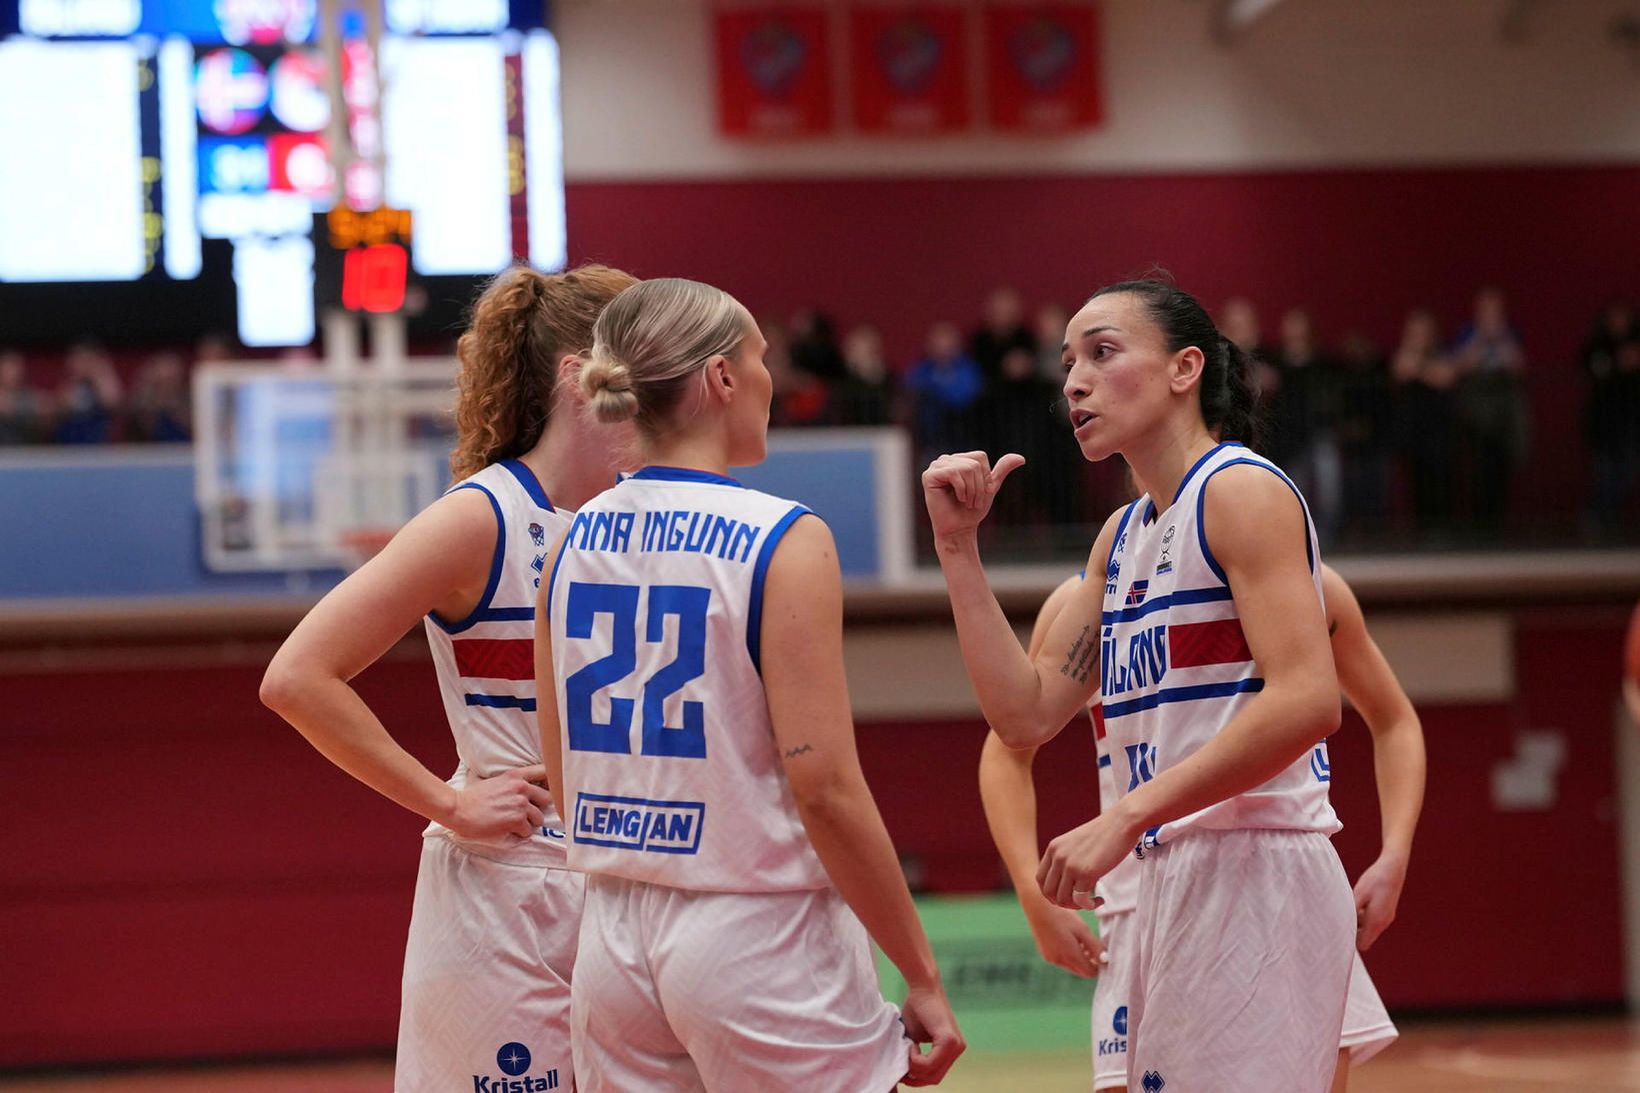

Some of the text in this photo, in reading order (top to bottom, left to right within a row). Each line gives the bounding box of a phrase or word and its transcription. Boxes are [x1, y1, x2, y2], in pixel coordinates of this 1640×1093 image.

[641, 511, 761, 563] INGUNN
[566, 582, 711, 759] 22
[472, 1069, 559, 1093] Kristall
